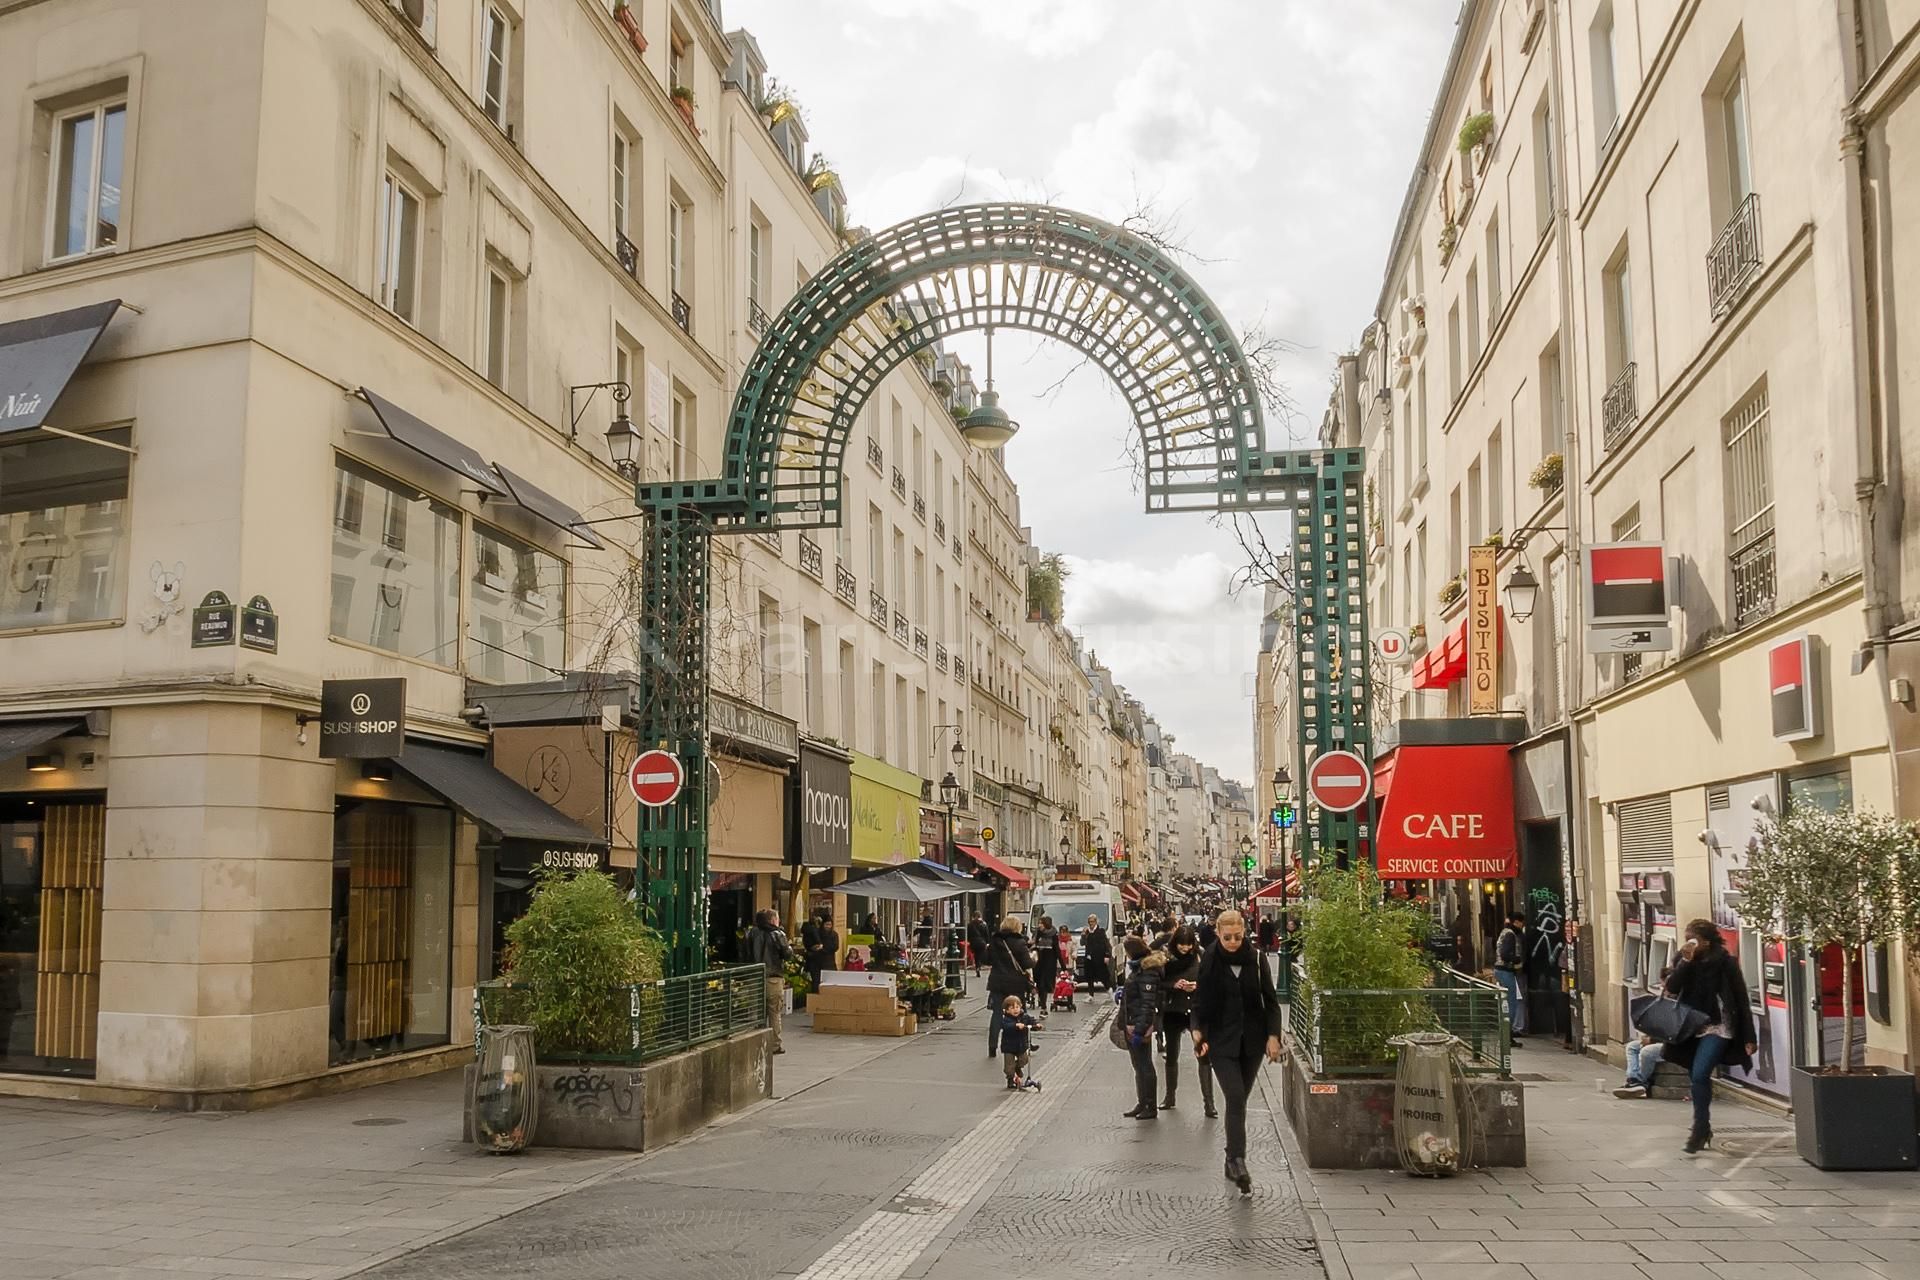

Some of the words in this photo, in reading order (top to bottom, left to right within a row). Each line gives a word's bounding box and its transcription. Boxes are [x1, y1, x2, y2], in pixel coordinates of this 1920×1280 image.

[932, 263, 1206, 449] MONTORGUEIL
[1383, 639, 1398, 653] U
[1476, 568, 1491, 691] BISTRO
[805, 770, 849, 845] happy
[1403, 814, 1485, 838] CAFE
[1388, 858, 1438, 873] SERVICE
[1444, 858, 1505, 874] CONTINU
